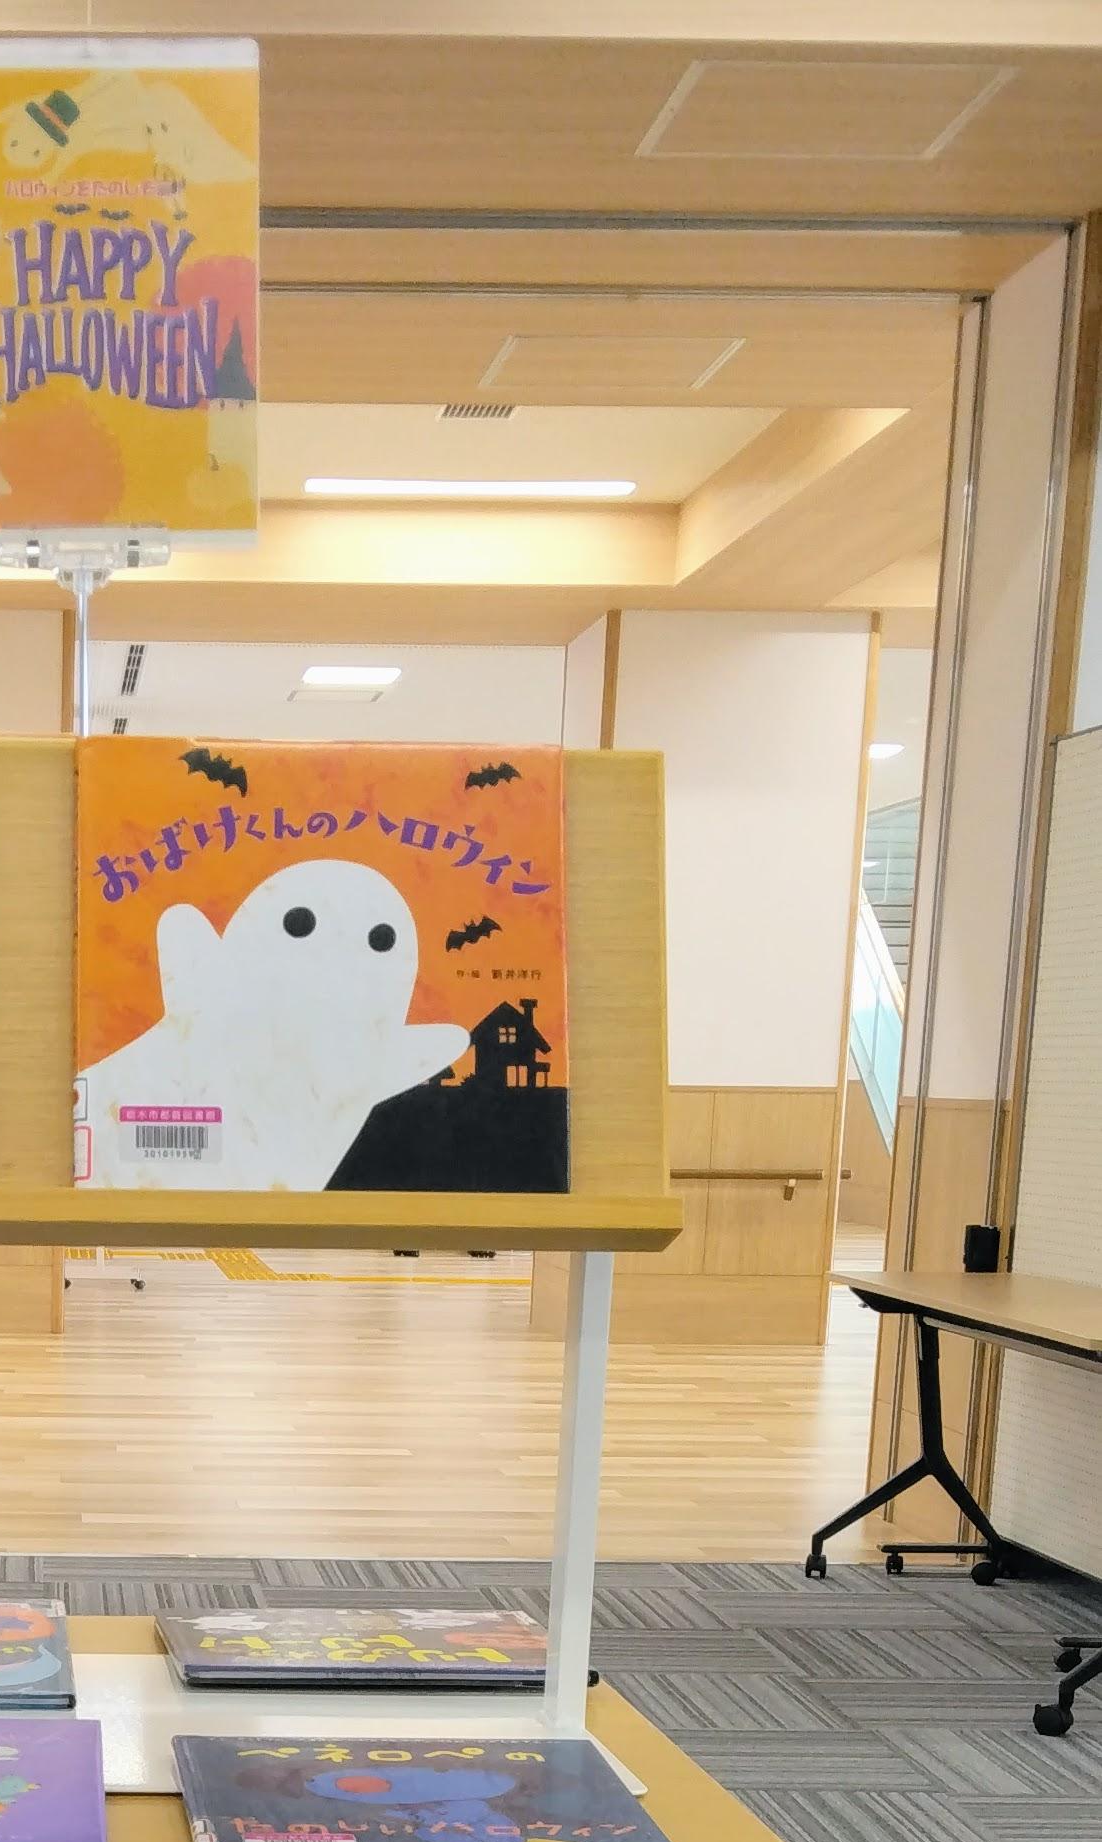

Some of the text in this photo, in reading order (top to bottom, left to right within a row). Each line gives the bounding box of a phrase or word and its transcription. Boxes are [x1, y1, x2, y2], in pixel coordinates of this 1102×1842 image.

[6, 219, 195, 308] HAPPY
[92, 805, 551, 903] おばけくんのハロウィン
[237, 1743, 546, 1763] ペネロペの
